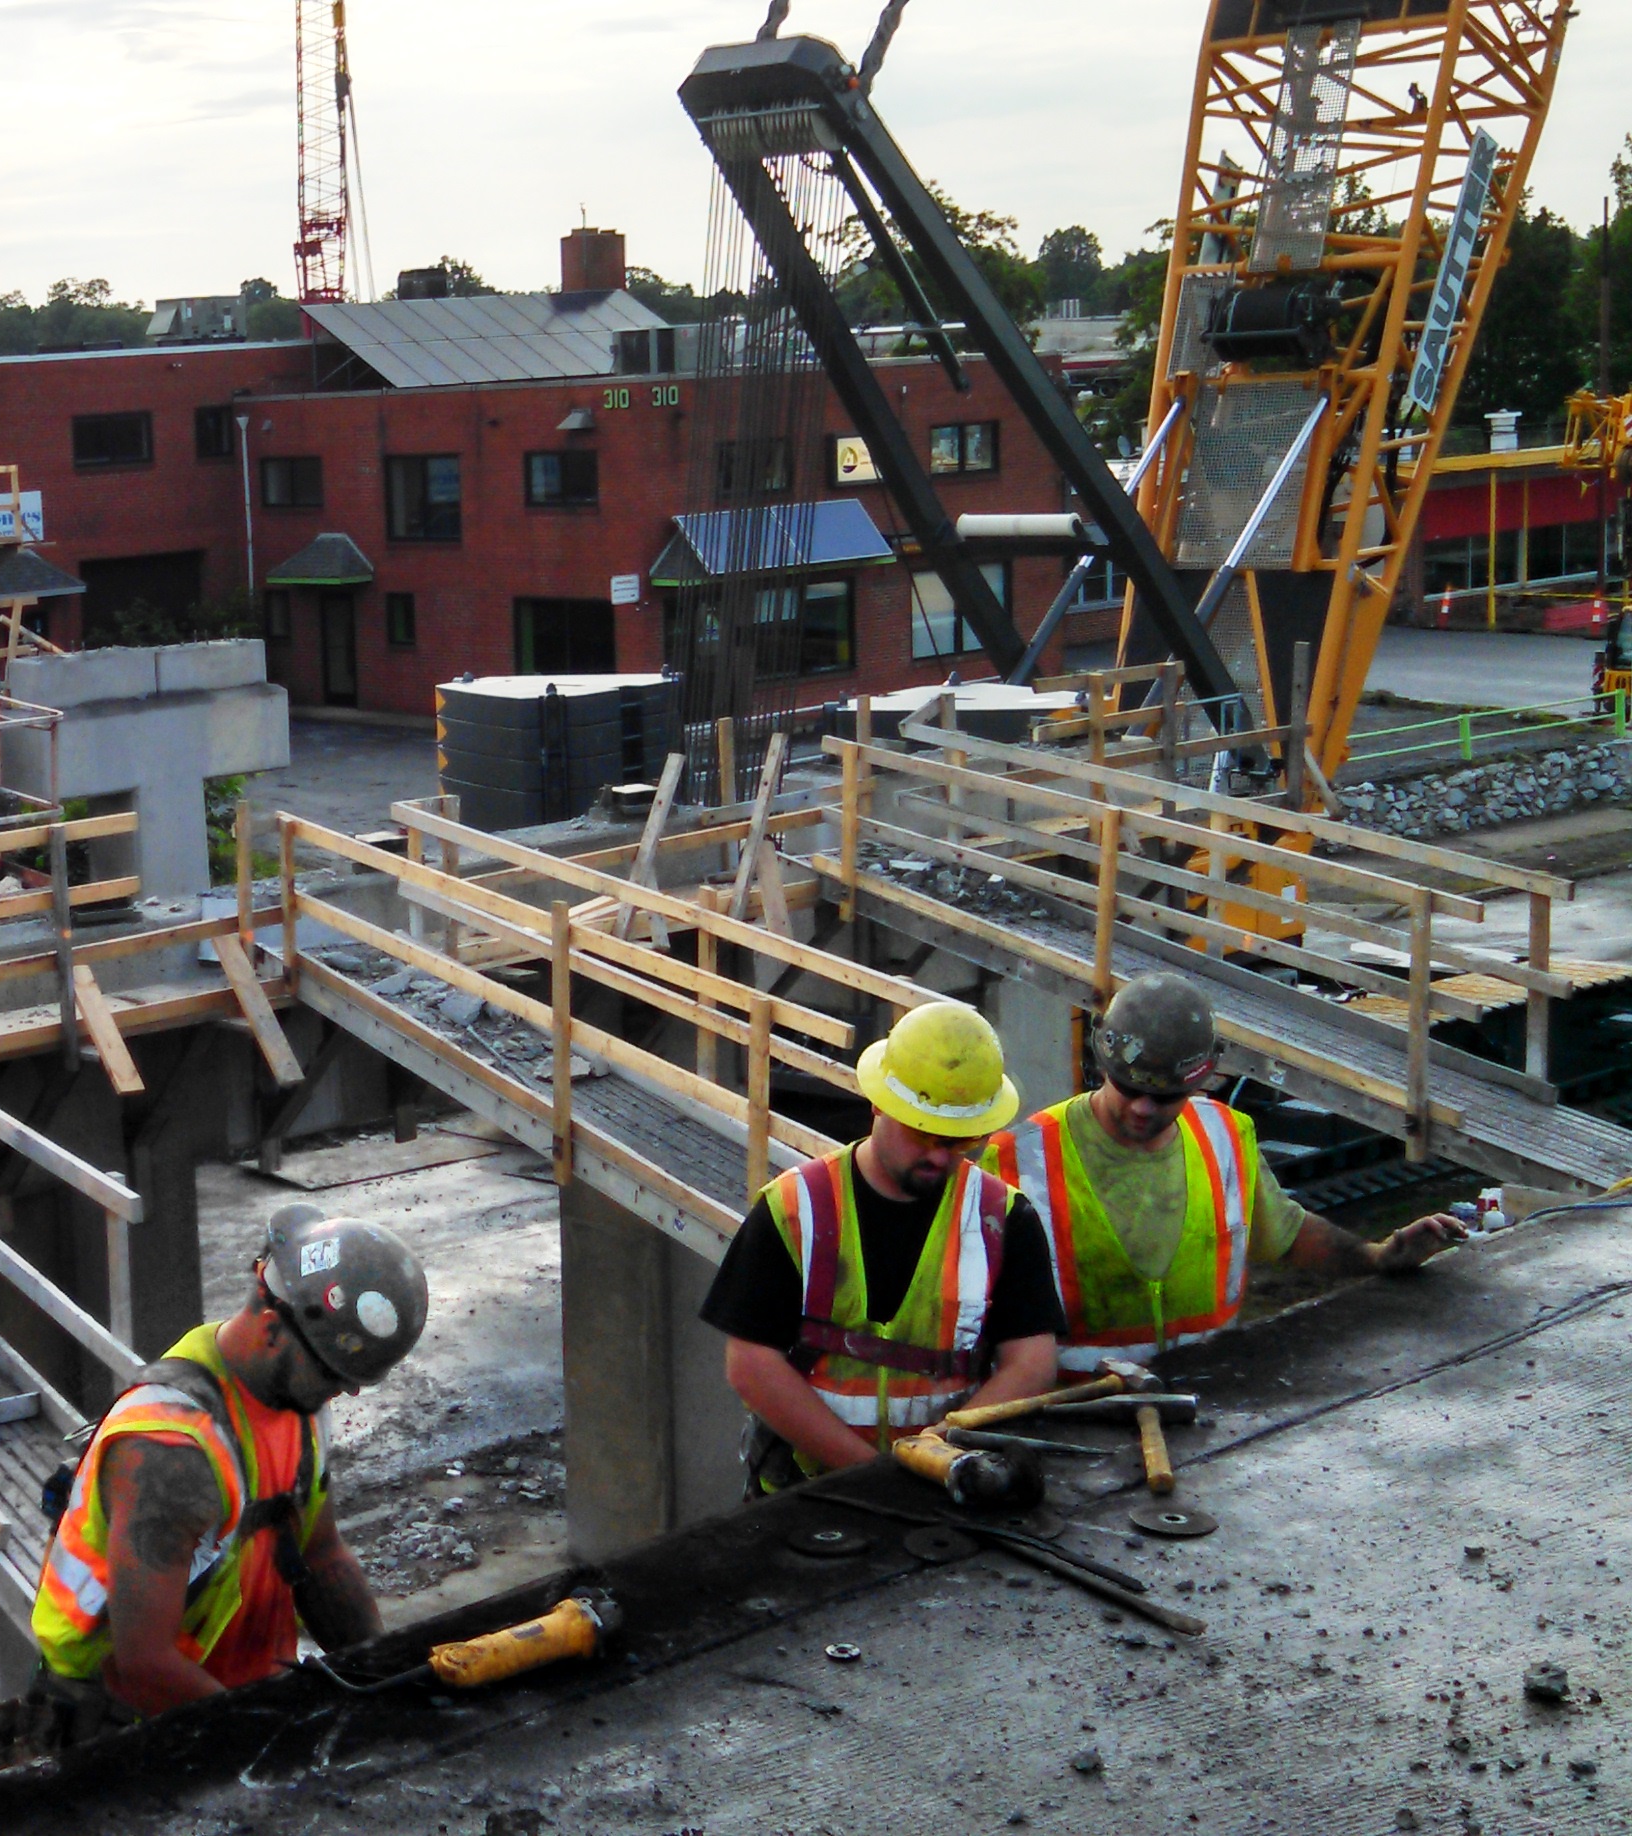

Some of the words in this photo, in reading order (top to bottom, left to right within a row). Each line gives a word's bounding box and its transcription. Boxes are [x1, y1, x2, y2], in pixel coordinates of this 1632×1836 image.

[1414, 136, 1494, 404] SAUTTER
[603, 388, 630, 409] 310
[651, 385, 679, 407] 310
